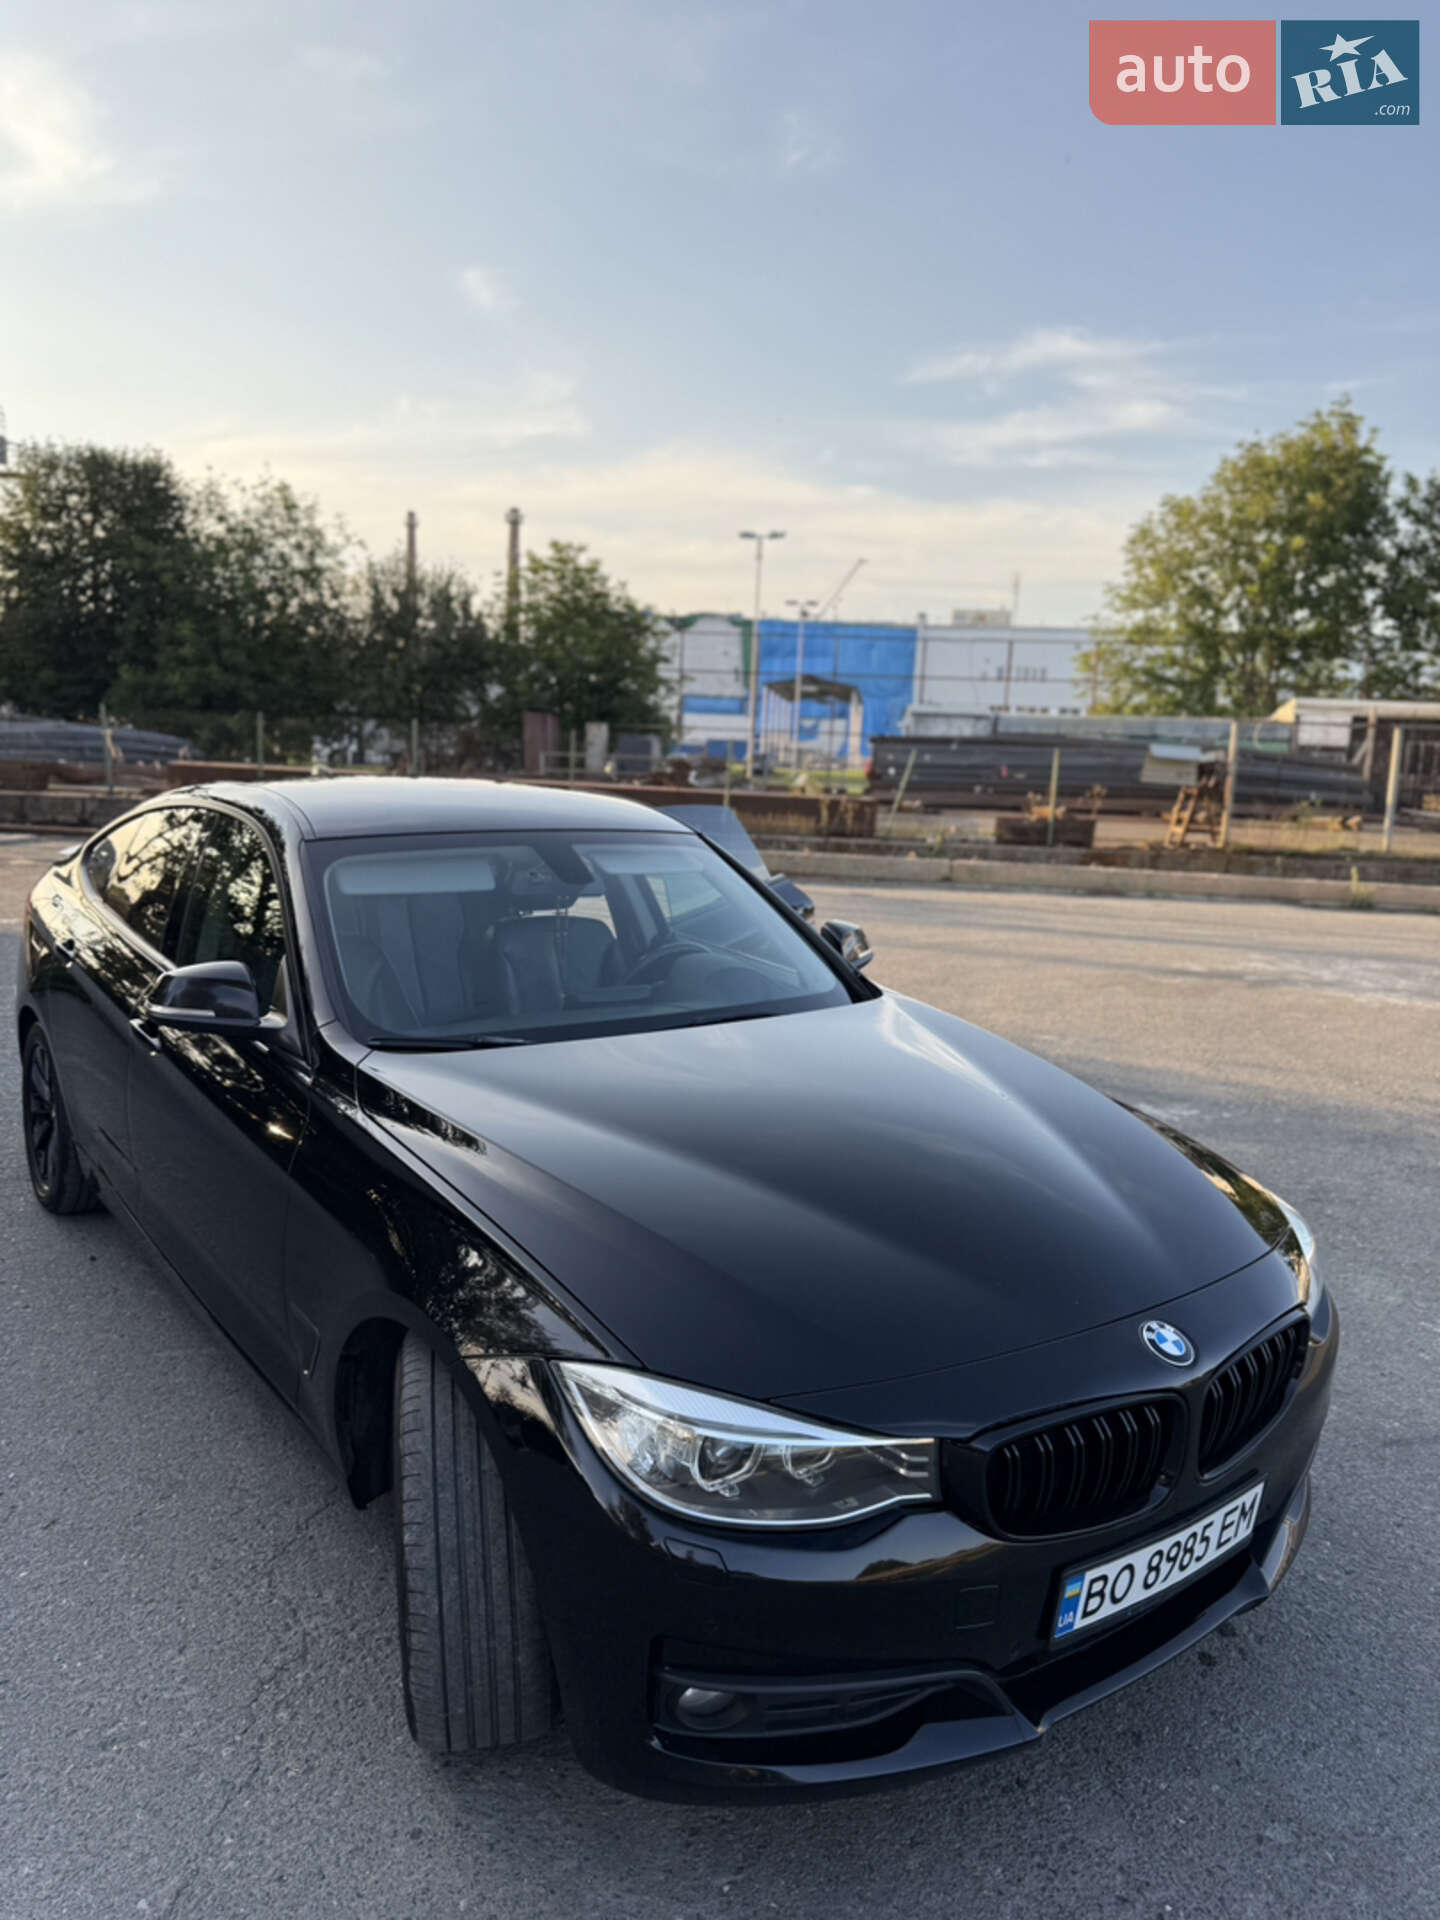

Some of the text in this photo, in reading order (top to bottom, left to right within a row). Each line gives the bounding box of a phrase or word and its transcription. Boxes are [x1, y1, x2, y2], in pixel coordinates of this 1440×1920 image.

[1080, 1492, 1259, 1620] BO 8985 EM
[1057, 1611, 1075, 1628] UA
